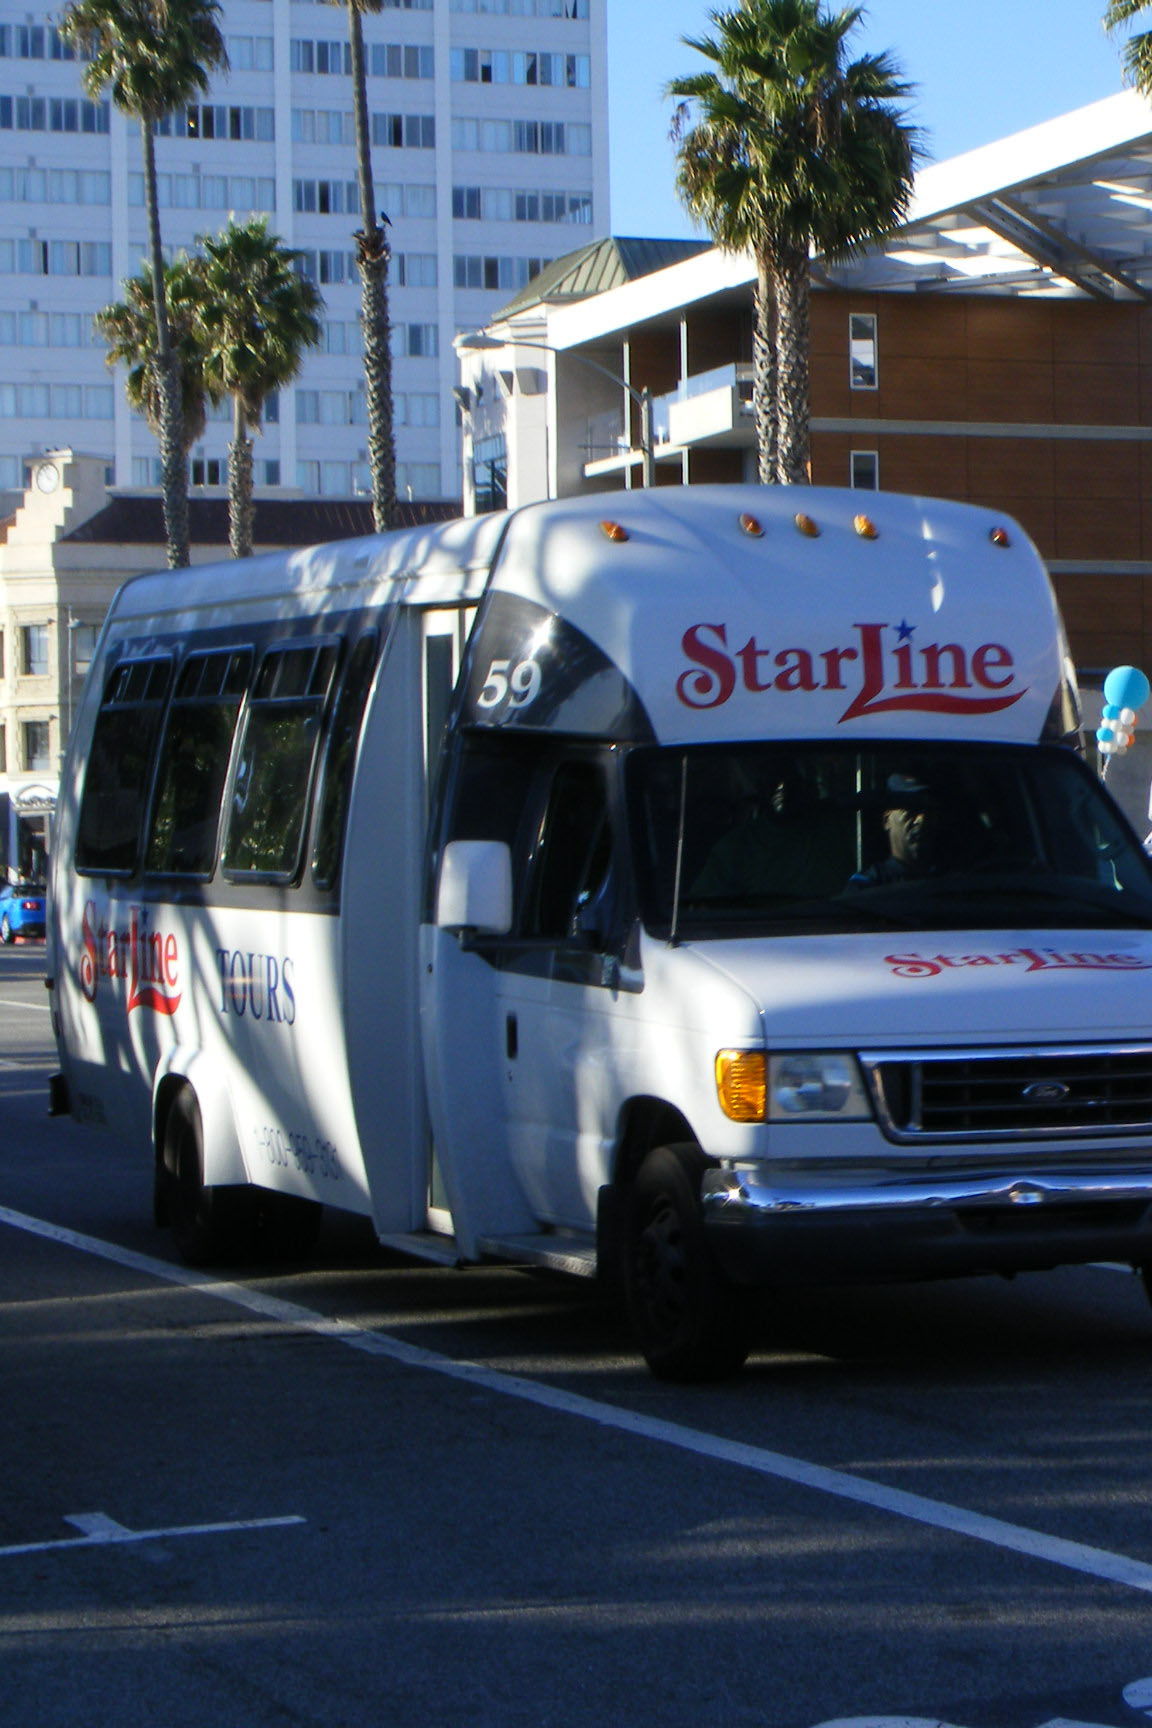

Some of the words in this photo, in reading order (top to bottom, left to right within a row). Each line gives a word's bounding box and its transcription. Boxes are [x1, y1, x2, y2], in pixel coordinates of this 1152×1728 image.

[477, 659, 542, 709] 59
[676, 621, 1030, 725] StarLine
[80, 900, 182, 1016] StarLine
[217, 948, 297, 1026] TOURS
